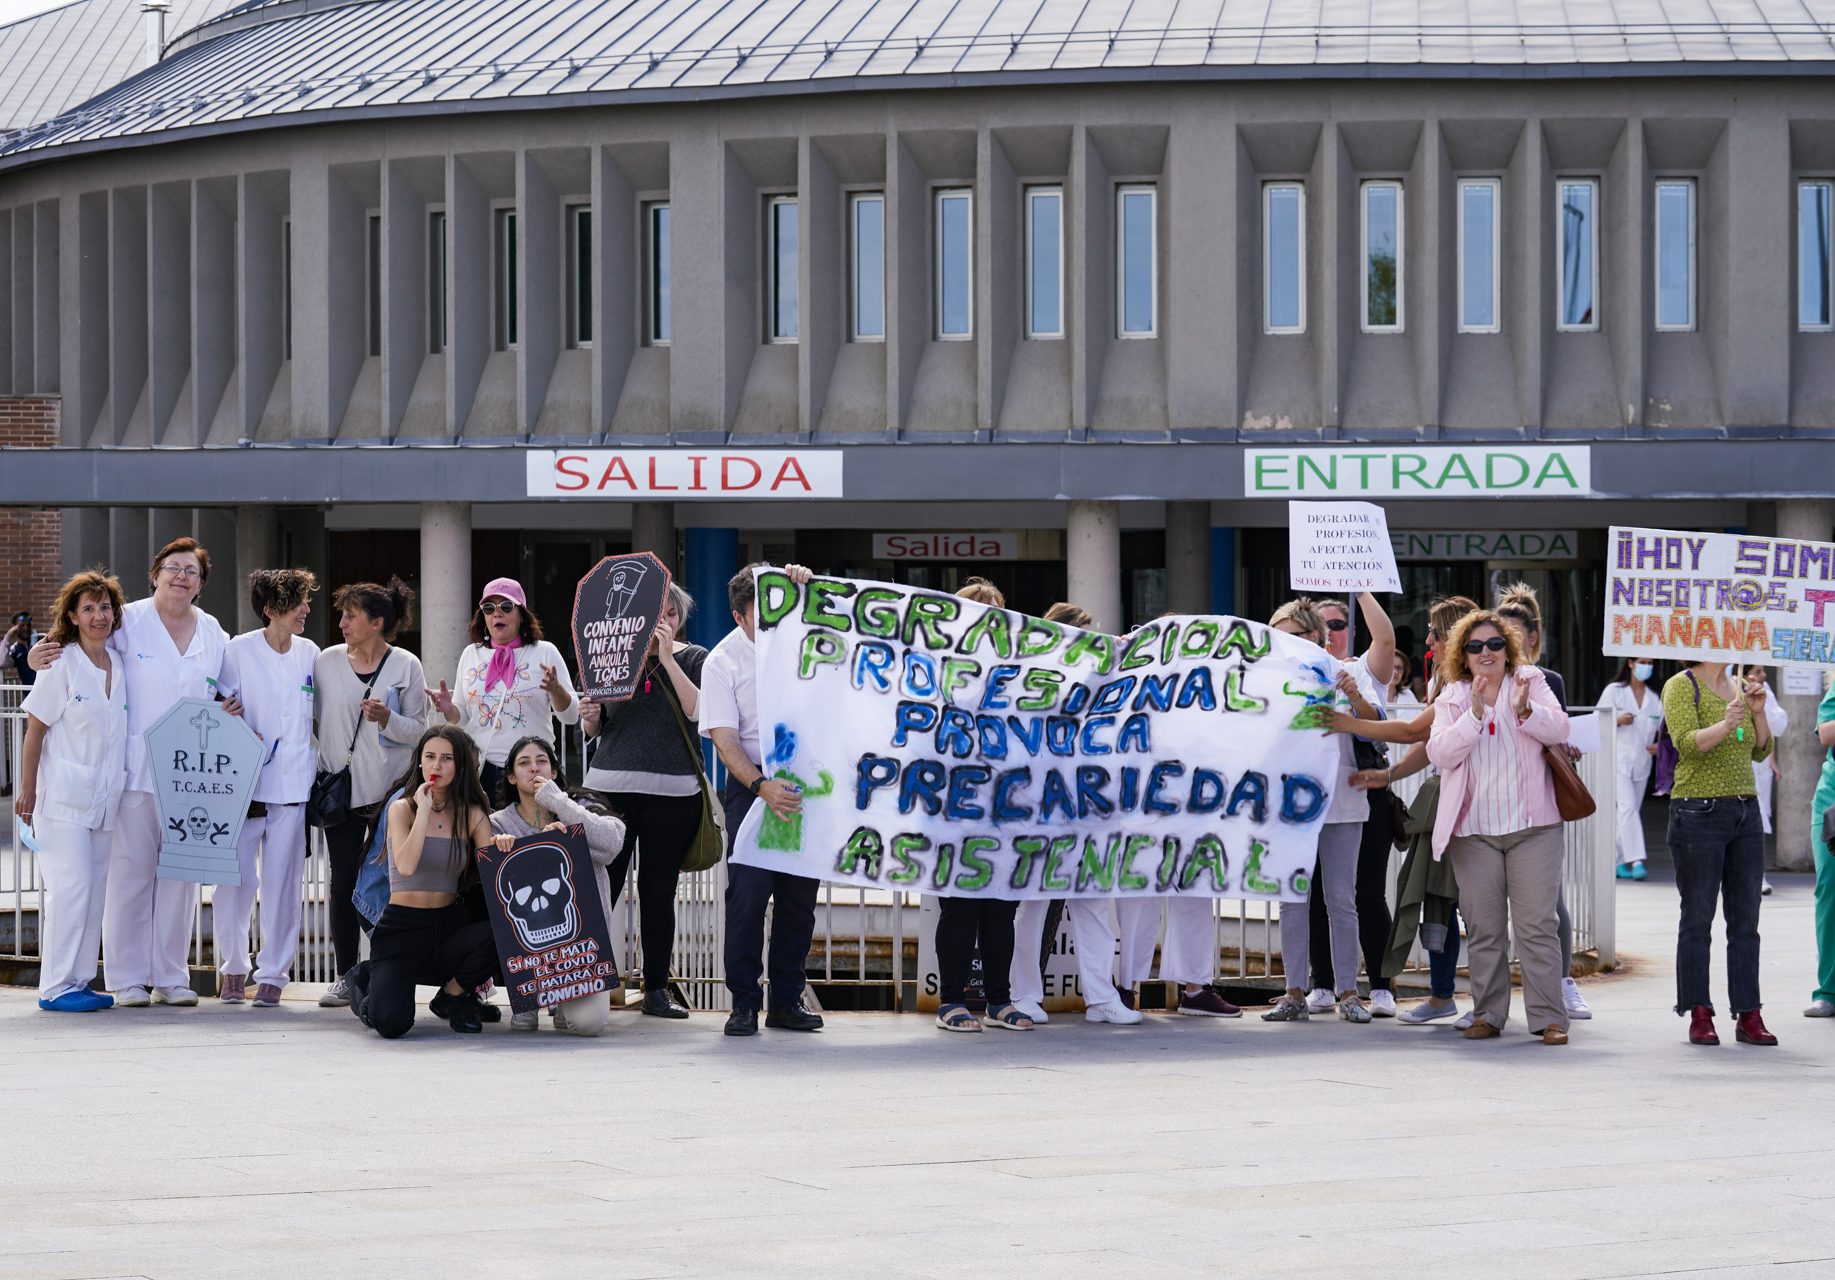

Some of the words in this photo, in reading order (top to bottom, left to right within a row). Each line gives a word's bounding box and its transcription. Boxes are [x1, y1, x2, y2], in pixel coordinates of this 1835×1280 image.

[555, 456, 812, 491] SALIDA
[1255, 453, 1578, 490] ENTRADA
[1307, 514, 1370, 523] DEGRADAR
[886, 535, 1001, 558] Salida
[1309, 541, 1373, 554] AFECTARÁ
[1301, 560, 1316, 569] TU
[1322, 557, 1383, 570] ATENCIÓN
[1734, 539, 1835, 581] SOM
[1295, 576, 1332, 587] SOMOS
[583, 616, 646, 638] CONVENIO
[757, 572, 1271, 675] DEGRADACION
[1612, 609, 1770, 651] MAÑANA
[588, 634, 637, 655] INFAME
[798, 629, 1269, 717] PROFESIONAL
[587, 687, 612, 697] SERVICIOS
[891, 700, 1151, 759] PROVOCA
[173, 750, 239, 775] R.I.P.
[172, 780, 234, 795] T.C.A.E.S
[857, 752, 1327, 826] PRECARIEDAD
[524, 955, 540, 969] NO
[543, 950, 558, 963] TE
[561, 940, 597, 959] MATA
[520, 981, 536, 993] TE
[597, 962, 614, 976] EL
[536, 965, 553, 977] EL
